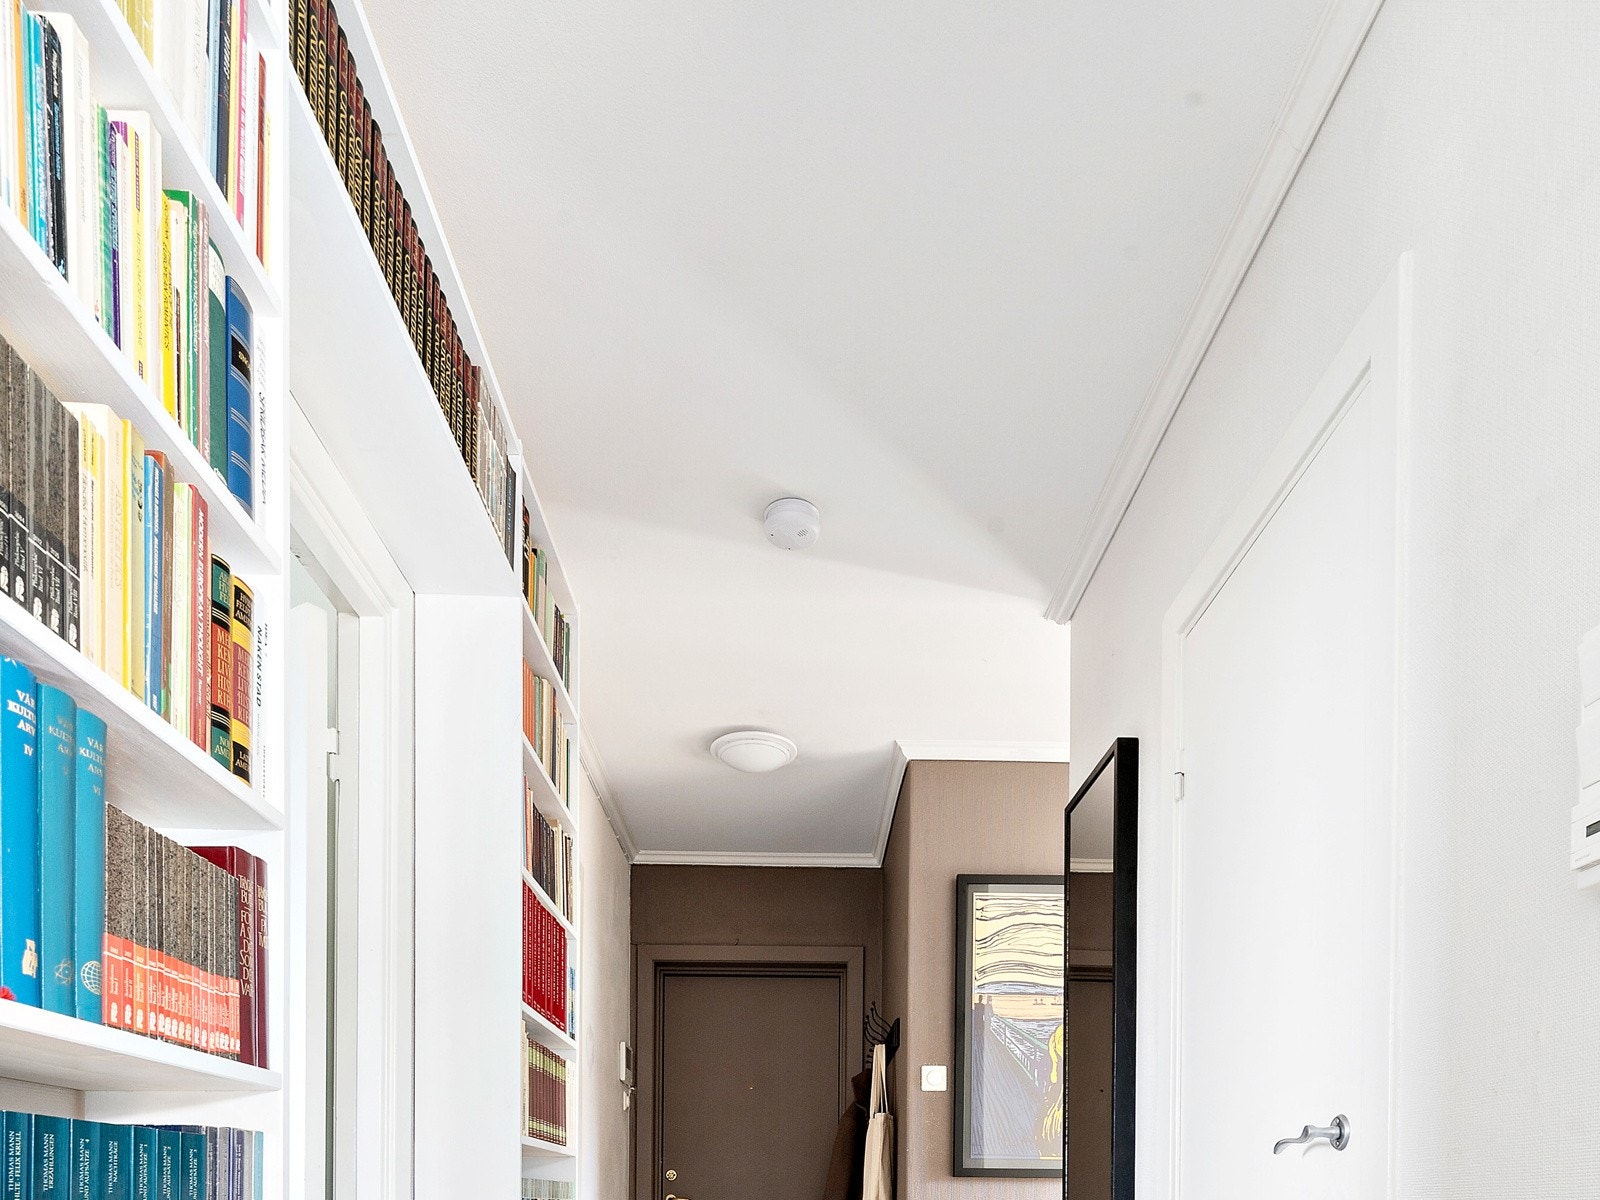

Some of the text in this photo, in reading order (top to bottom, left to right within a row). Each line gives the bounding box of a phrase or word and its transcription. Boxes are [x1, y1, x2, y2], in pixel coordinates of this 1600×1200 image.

[17, 719, 35, 736] ARV
[24, 744, 34, 756] IV
[88, 763, 103, 778] ARV
[93, 785, 101, 796] VI
